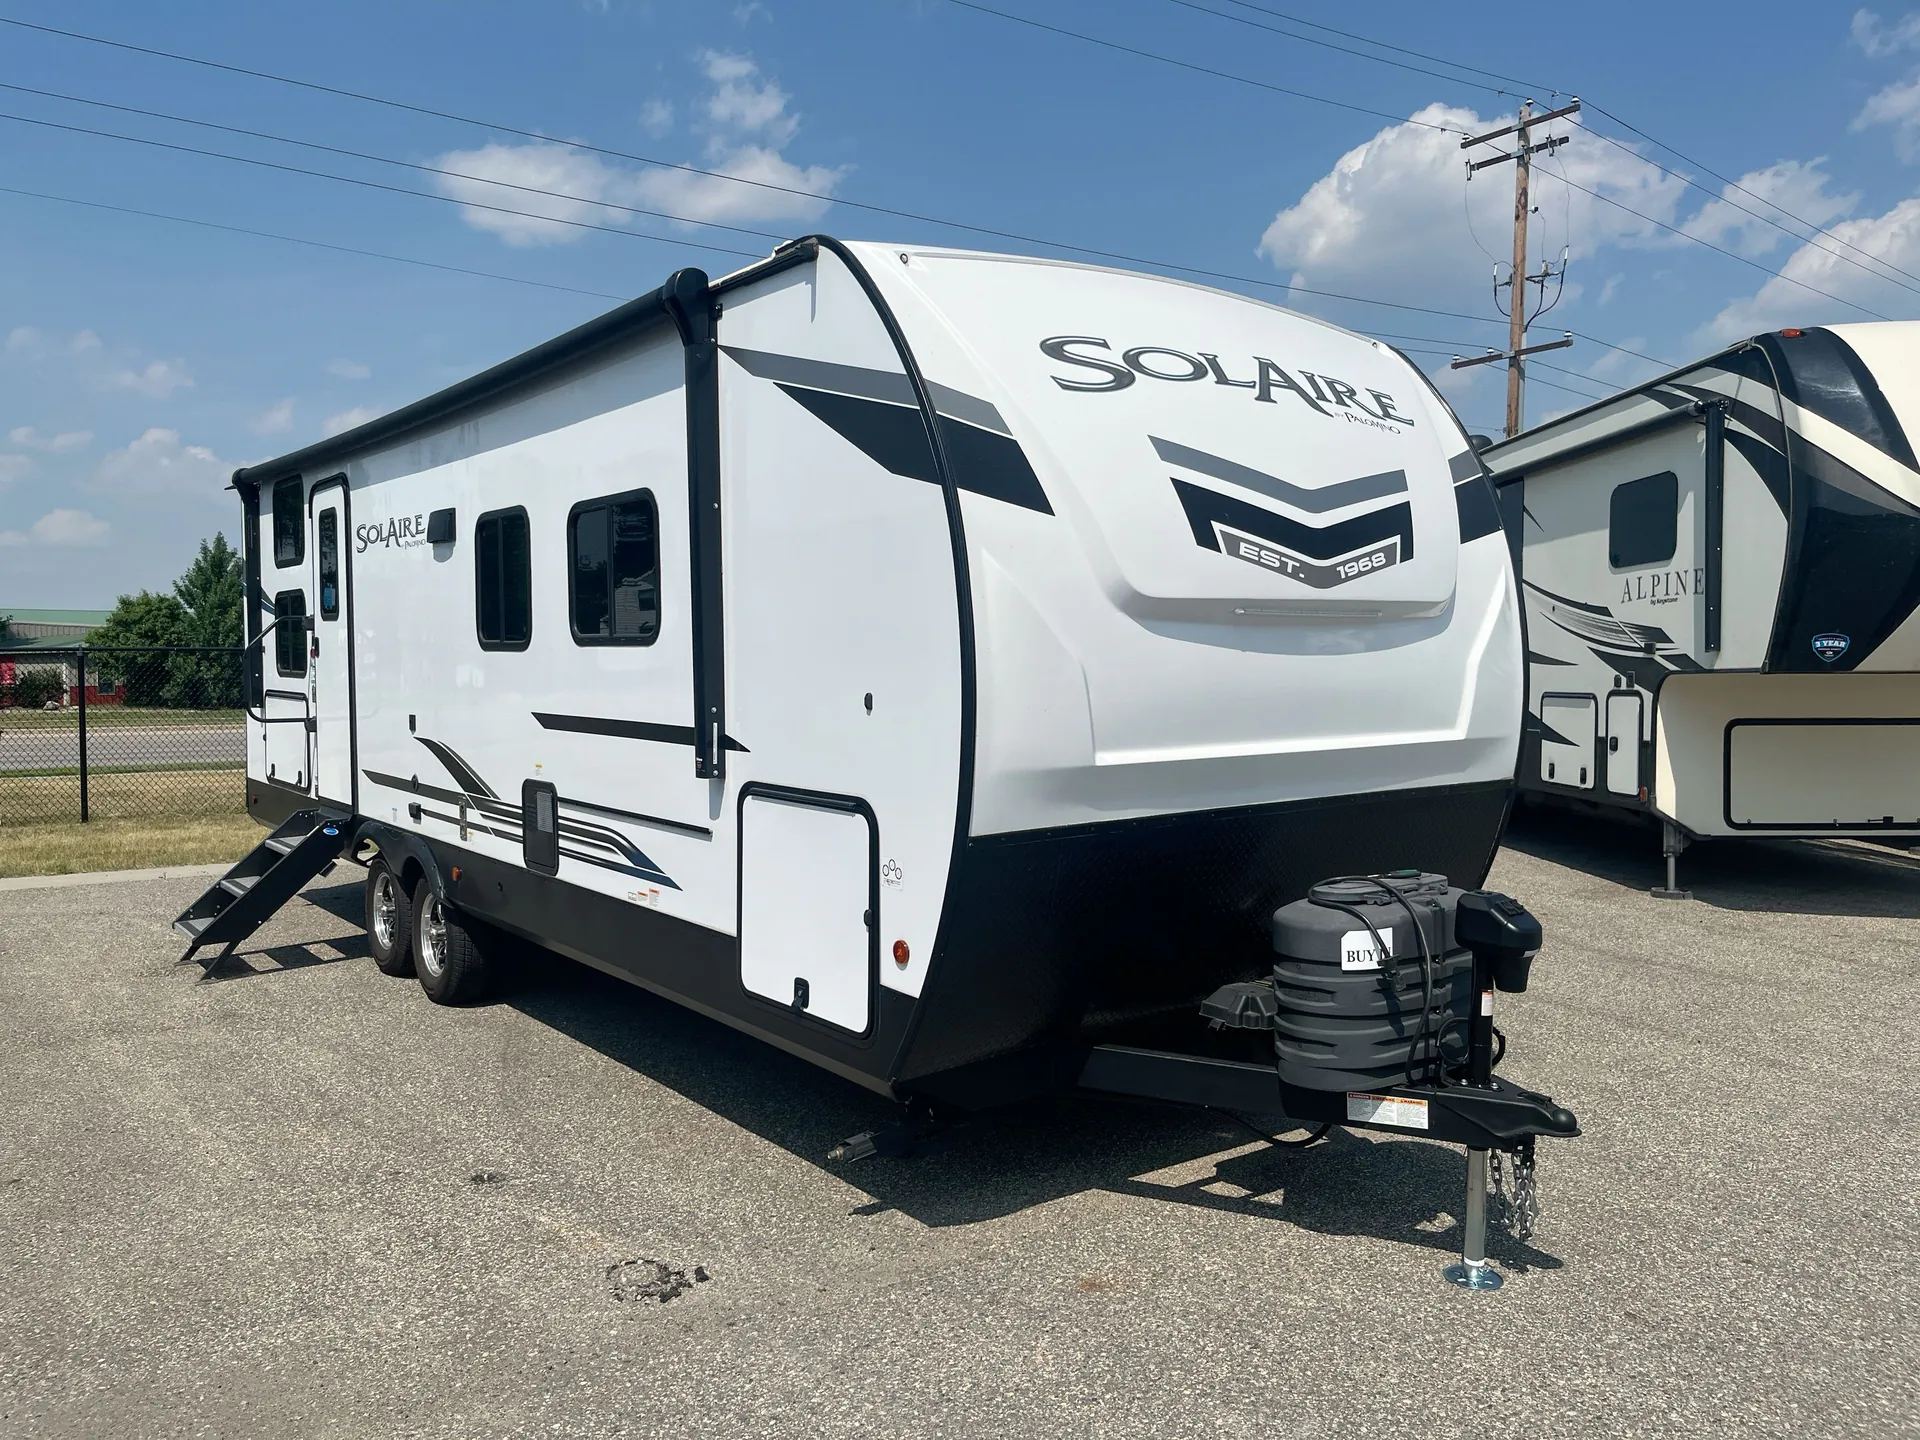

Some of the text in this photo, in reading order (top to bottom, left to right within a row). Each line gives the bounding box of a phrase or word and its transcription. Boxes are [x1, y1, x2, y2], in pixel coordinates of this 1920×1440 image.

[1040, 335, 1415, 427] SOLAIRE
[1344, 411, 1401, 435] PALOMINO
[356, 514, 426, 554] SOLAIRE
[1239, 541, 1387, 579] EST. 1968
[1620, 567, 1705, 604] ALPINE
[1822, 640, 1846, 648] YEAR
[1346, 949, 1376, 962] BUY
